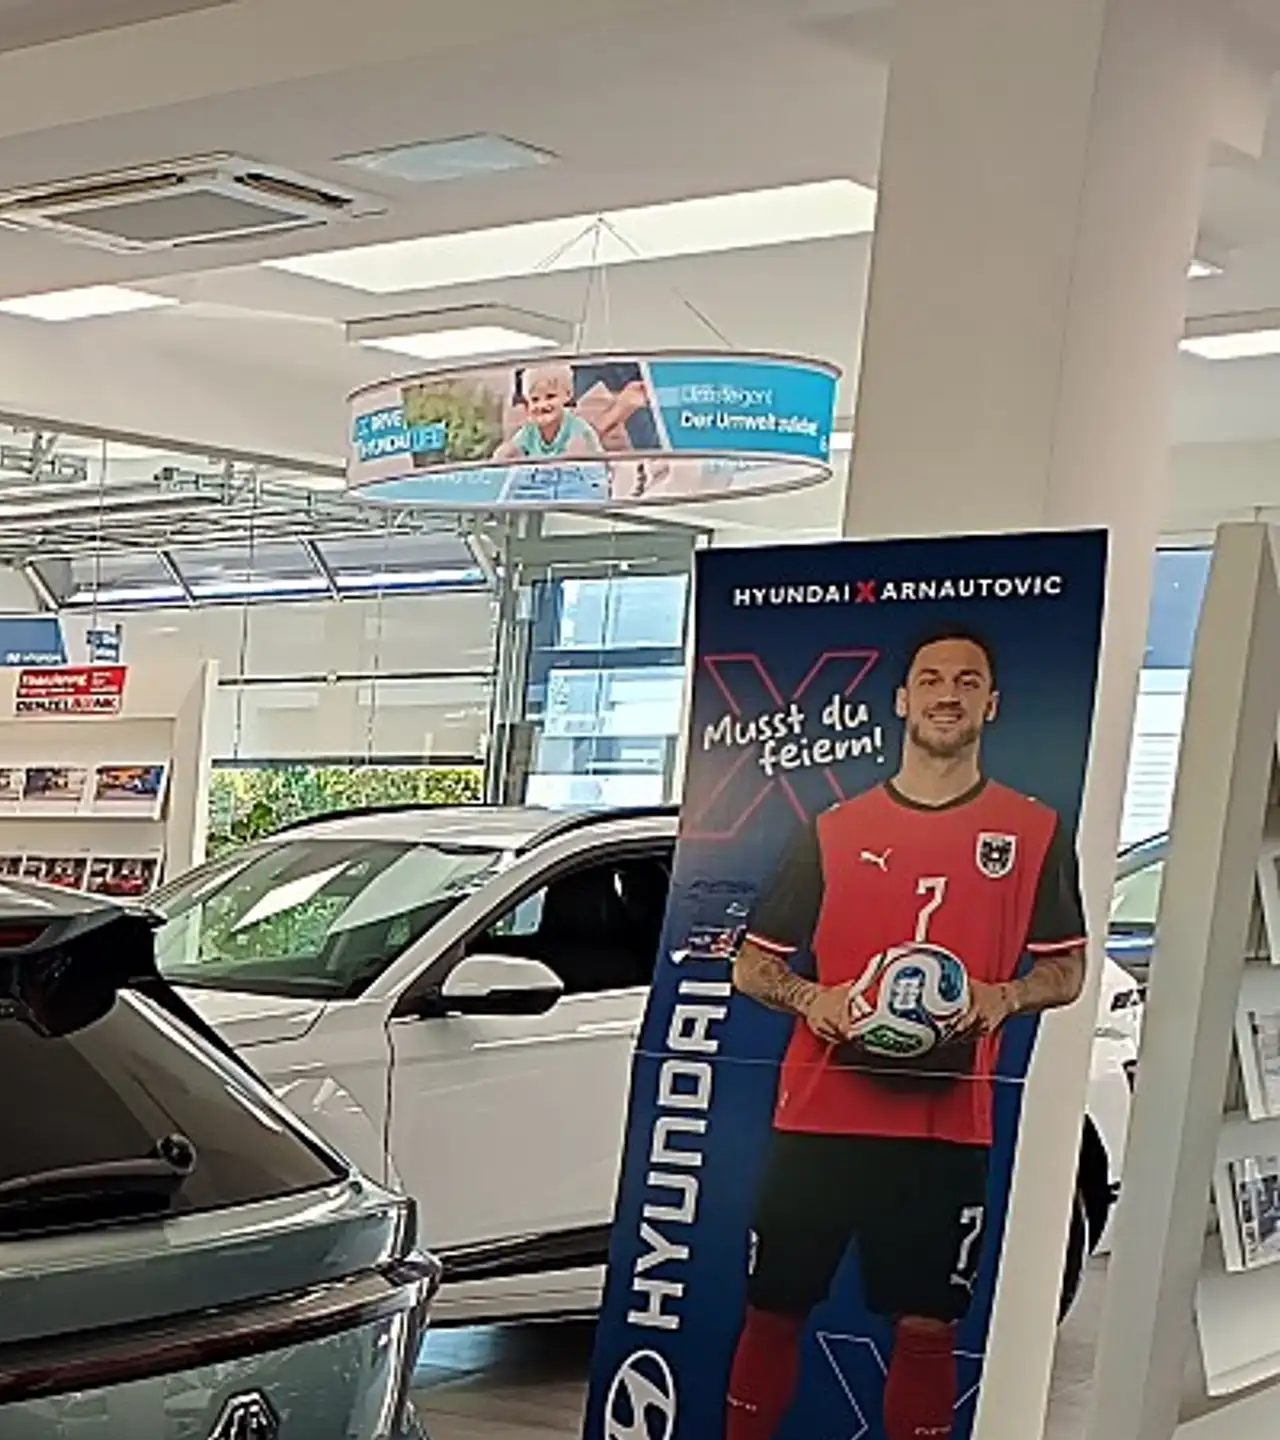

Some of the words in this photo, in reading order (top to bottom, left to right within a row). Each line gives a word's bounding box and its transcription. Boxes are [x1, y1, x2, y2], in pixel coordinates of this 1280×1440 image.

[733, 583, 850, 606] HYUNDAI
[855, 580, 876, 604] X
[879, 575, 1063, 600] ARNAUTOVIC
[703, 703, 805, 751] Musst
[822, 693, 869, 732] du
[759, 726, 885, 777] feiern!
[915, 876, 948, 943] 7
[626, 981, 733, 1330] HYUNDAI
